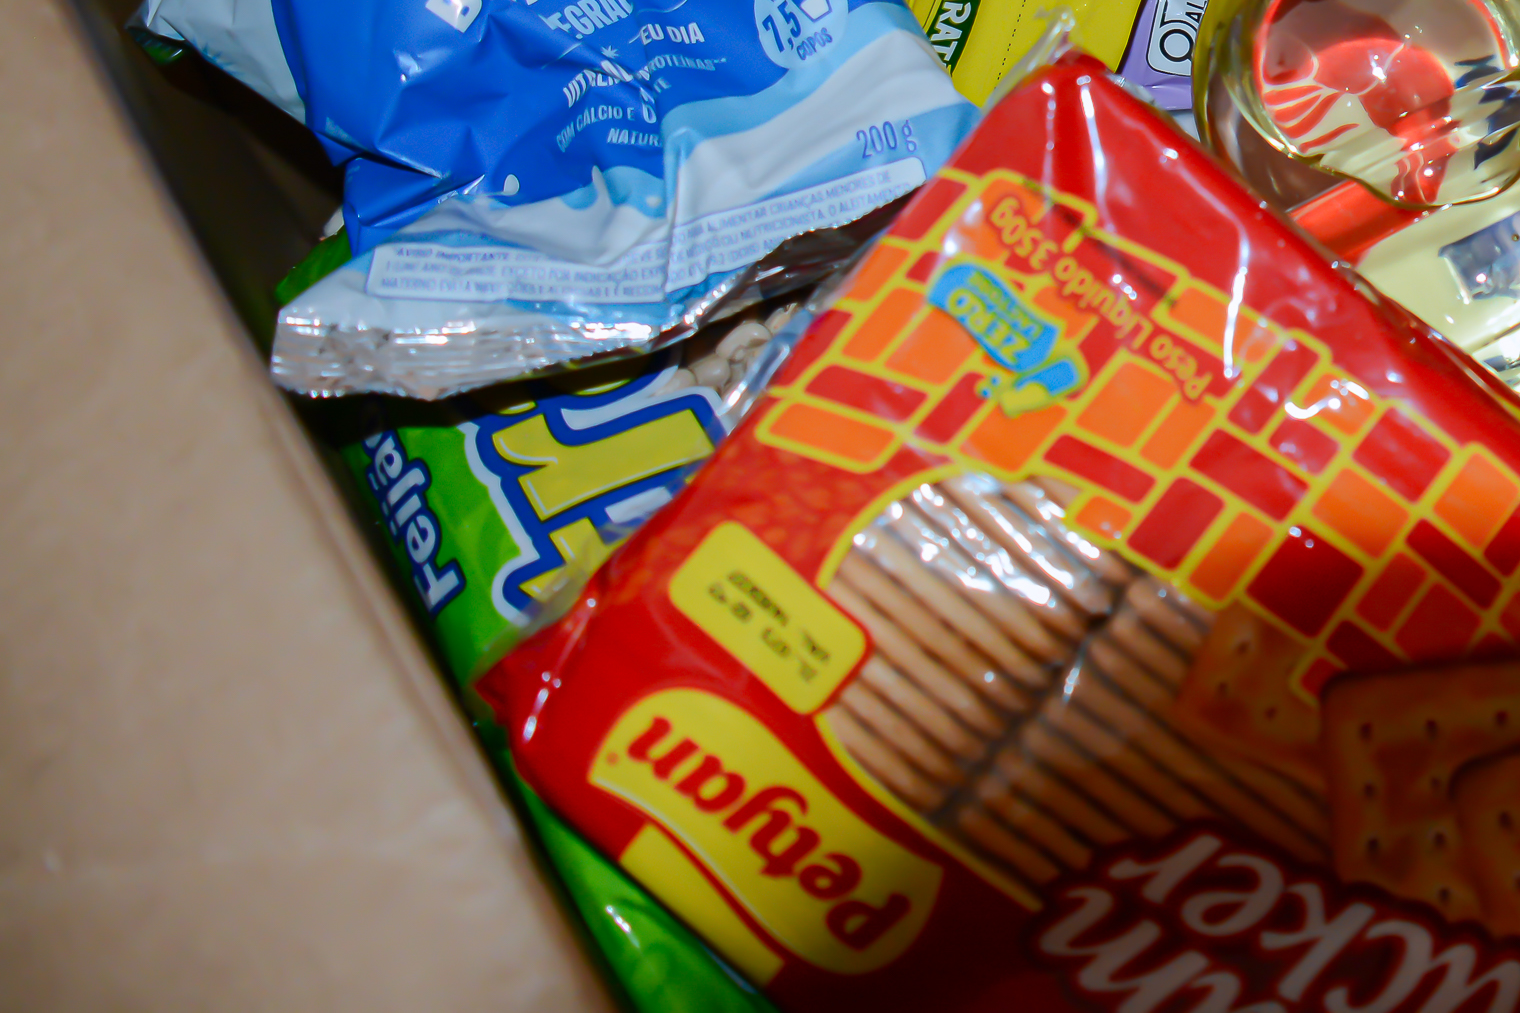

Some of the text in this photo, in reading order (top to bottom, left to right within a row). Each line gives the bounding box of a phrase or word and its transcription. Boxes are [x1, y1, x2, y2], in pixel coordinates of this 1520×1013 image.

[640, 23, 663, 45] EU
[667, 22, 705, 44] DIA
[796, 28, 834, 62] COPOS
[855, 120, 919, 160] 200 g
[947, 287, 1032, 366] ZERO
[990, 197, 1212, 400] Peso Líquido 350g
[626, 716, 912, 953] Petyan
